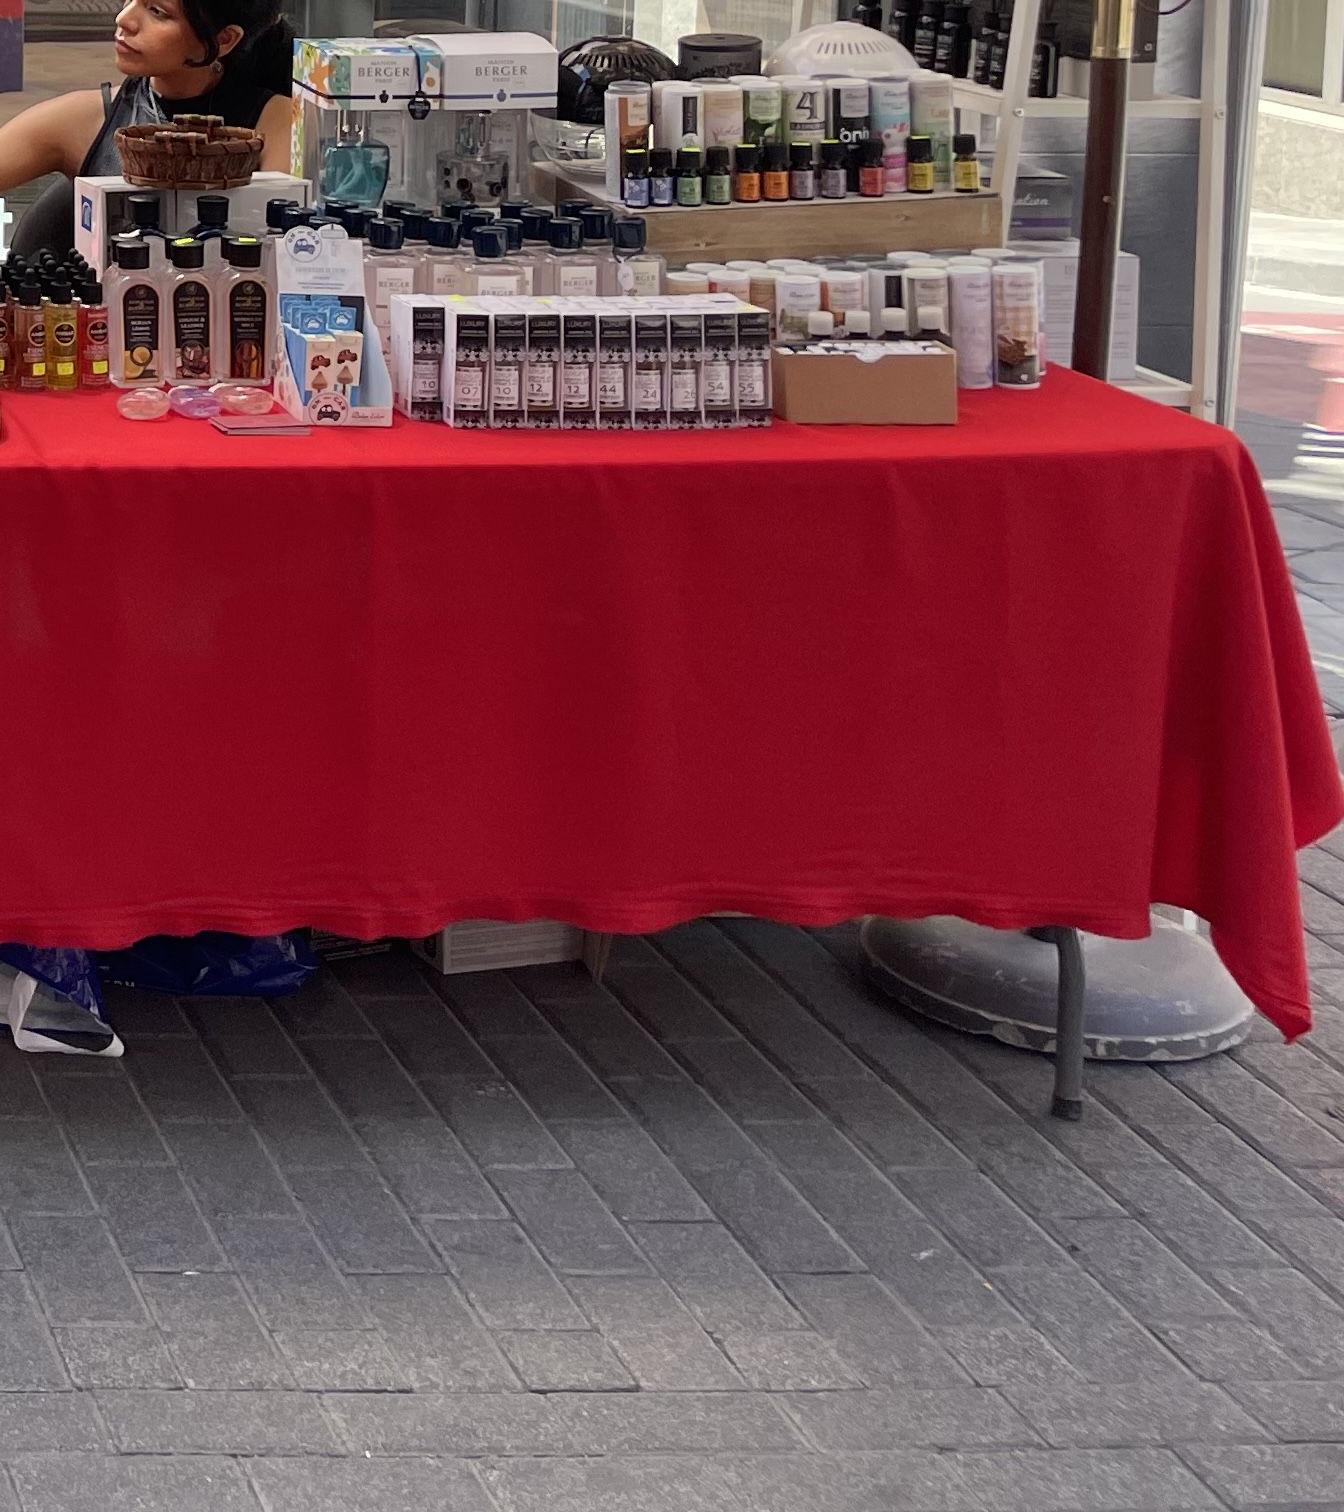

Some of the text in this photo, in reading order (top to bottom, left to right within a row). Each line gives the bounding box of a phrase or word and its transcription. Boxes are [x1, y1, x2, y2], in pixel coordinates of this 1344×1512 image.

[358, 66, 410, 77] BERGER
[475, 65, 528, 77] BERGER
[530, 383, 543, 393] 12
[568, 385, 580, 394] 12
